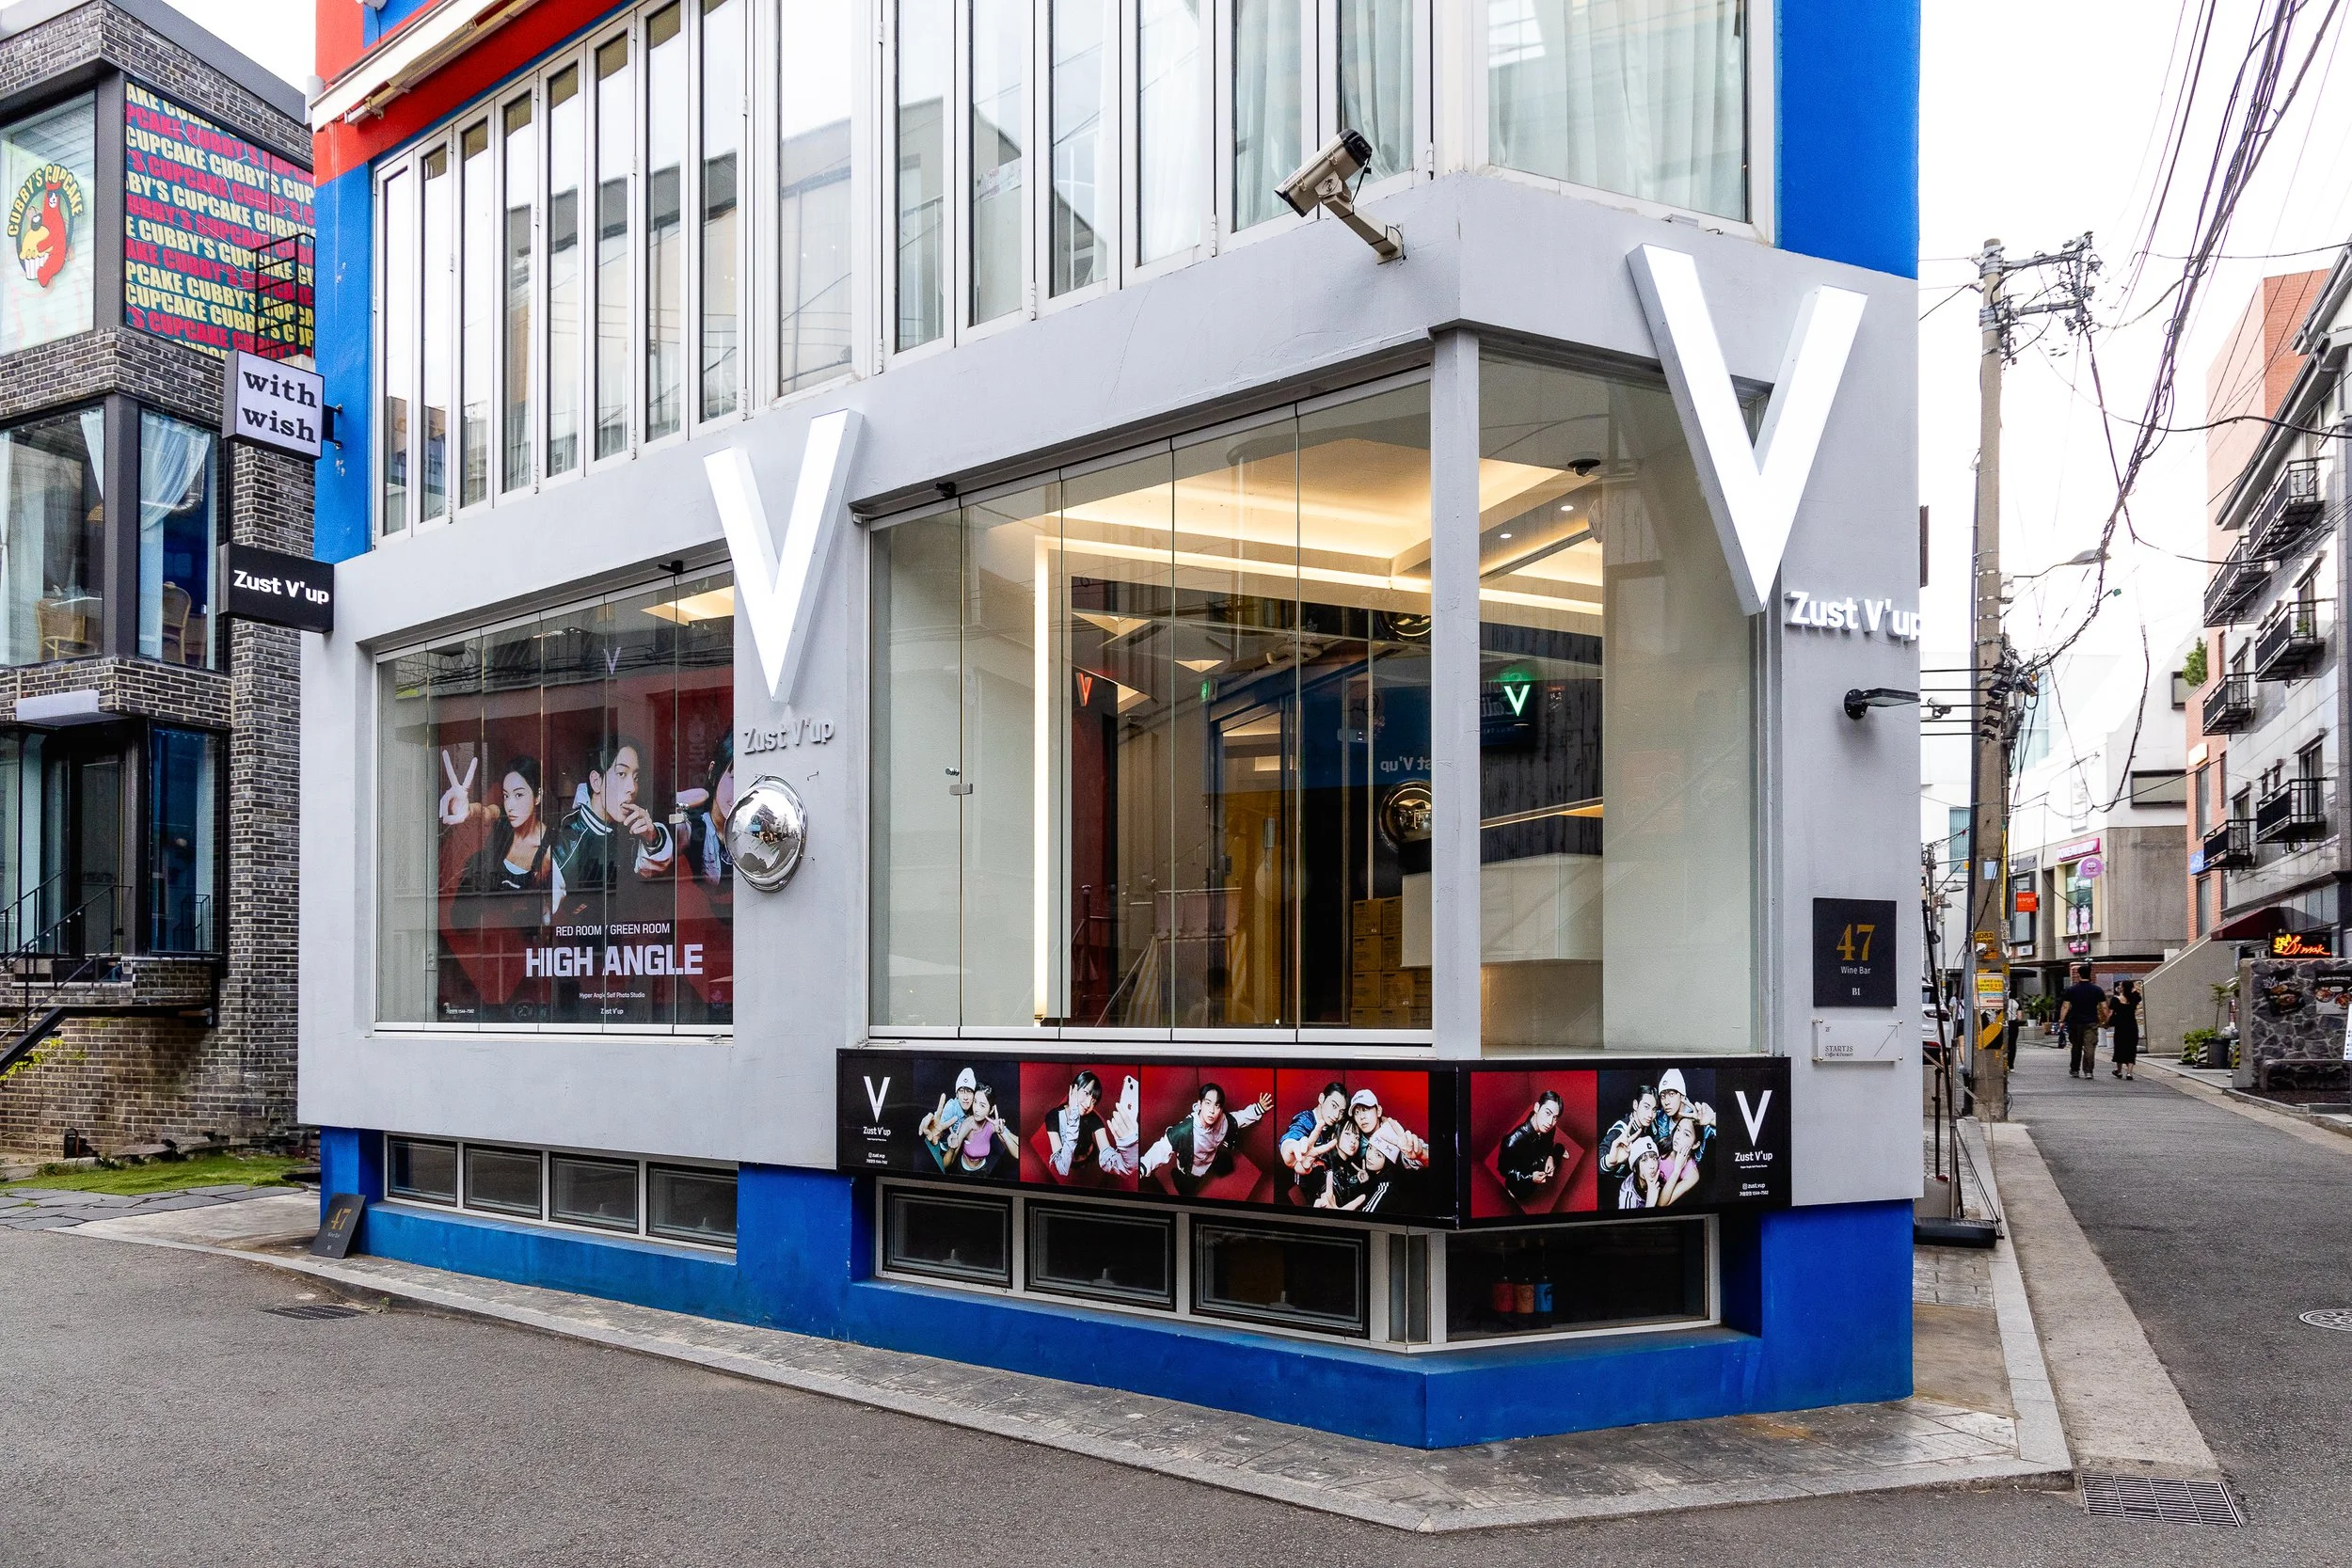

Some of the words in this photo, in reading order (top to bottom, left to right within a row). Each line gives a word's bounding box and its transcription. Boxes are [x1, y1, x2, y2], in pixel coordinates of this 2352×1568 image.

[126, 125, 207, 171] CUPCAKE
[209, 153, 280, 195] CUBBY'S
[185, 124, 259, 166] CUBBY'S
[148, 155, 229, 199] CUPCAKE
[8, 168, 43, 236] CUBBY'S
[44, 164, 84, 216] CUPCAKE
[172, 185, 251, 229] CUPCAKE
[138, 219, 216, 260] CUBBY'S
[126, 261, 184, 294] PCAKE
[186, 277, 257, 313] CUBBY'S
[163, 248, 239, 287] CUBBY'S
[126, 283, 207, 322] CUPCAKE
[209, 304, 281, 340] CUBBY'S
[148, 311, 230, 349] CUPCAKE
[243, 371, 317, 408] with
[242, 407, 316, 443] wish
[1628, 243, 1868, 616] V
[703, 408, 860, 705] V
[233, 569, 282, 595] Zust
[285, 579, 329, 605] V'up
[1785, 591, 1859, 631] Zust
[1861, 597, 1921, 641] V'up
[1503, 685, 1531, 717] V
[743, 723, 787, 755] Zust
[792, 716, 835, 747] V'up
[556, 925, 574, 937] RED
[576, 925, 602, 936] ROOM
[610, 924, 641, 935] GREEN
[643, 923, 671, 934] ROOM
[1836, 924, 1875, 961] 47
[526, 946, 594, 977] HIGH
[602, 943, 704, 976] ANGLE
[1840, 966, 1858, 974] Wine
[1859, 966, 1871, 974] Bar
[863, 1076, 891, 1123] V
[1735, 1090, 1772, 1147] V
[863, 1126, 877, 1135] Zust
[877, 1126, 892, 1137] V'up
[1735, 1151, 1754, 1163] Zust
[1755, 1149, 1773, 1162] V'up
[330, 1208, 352, 1230] 47
